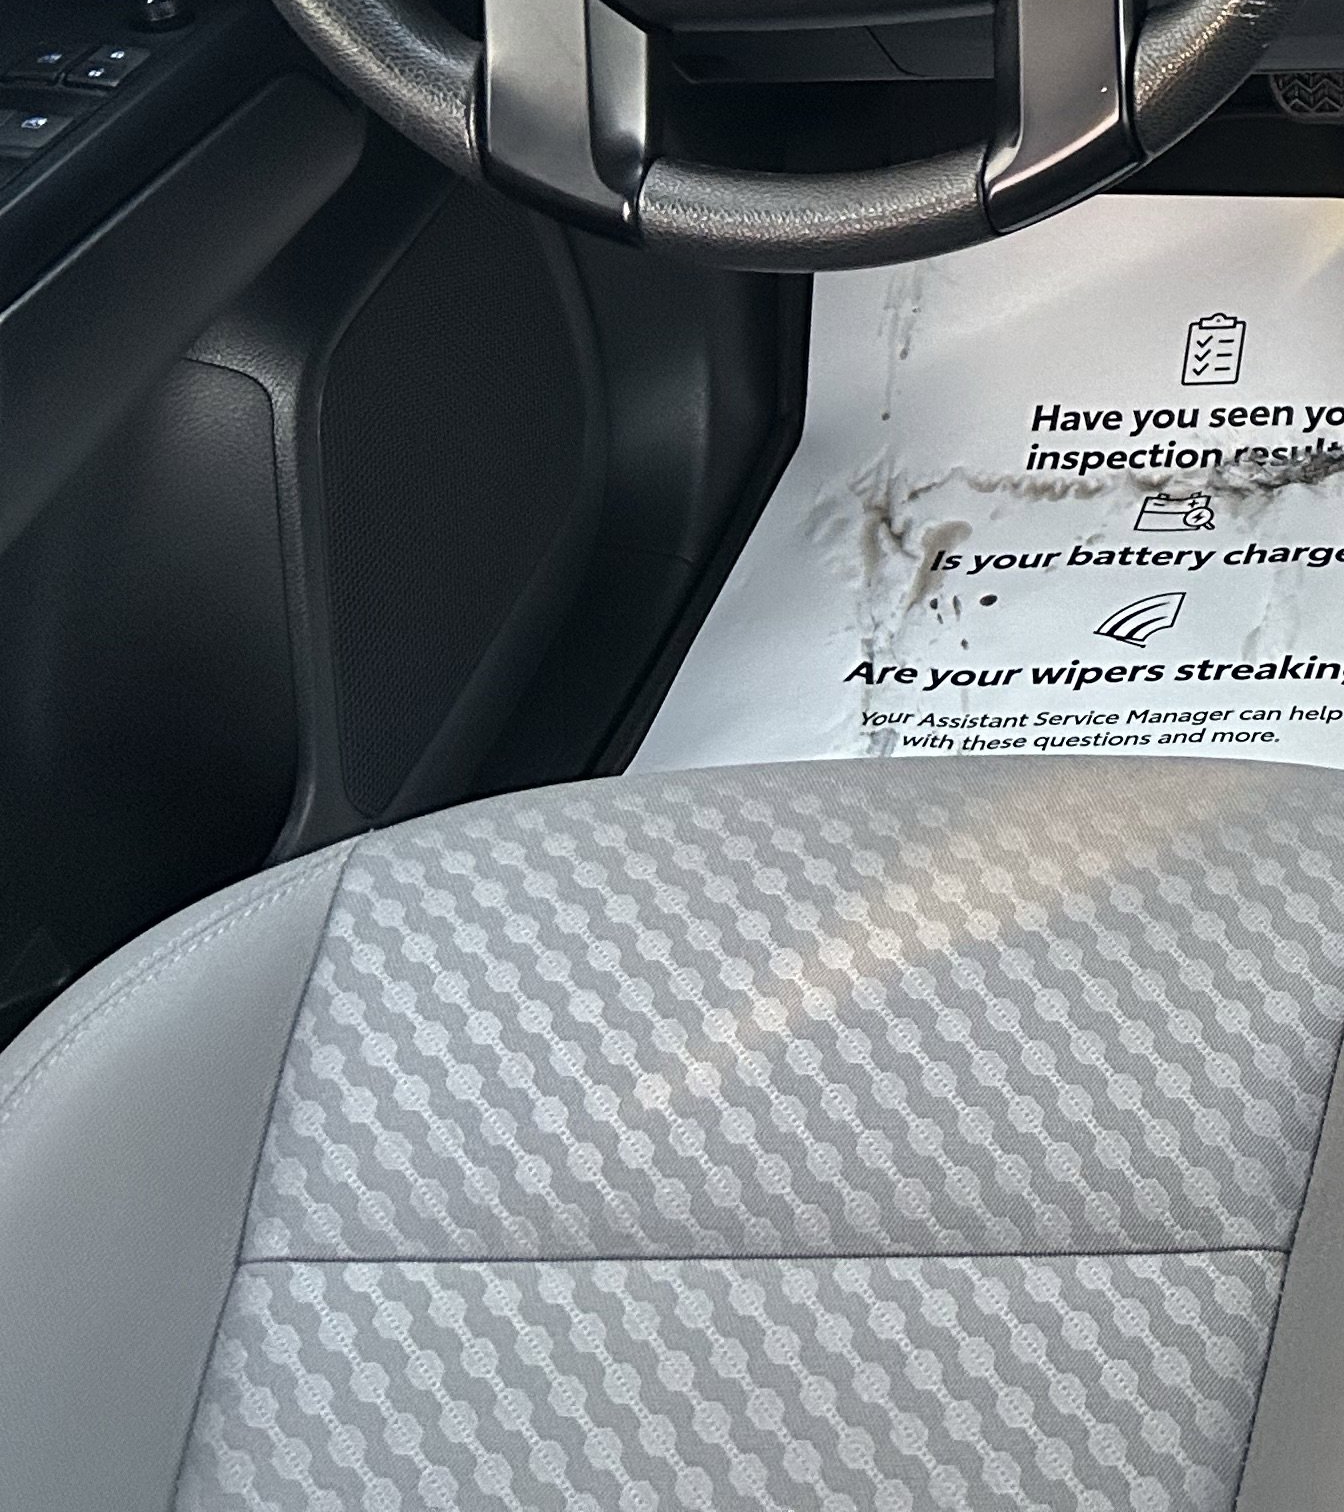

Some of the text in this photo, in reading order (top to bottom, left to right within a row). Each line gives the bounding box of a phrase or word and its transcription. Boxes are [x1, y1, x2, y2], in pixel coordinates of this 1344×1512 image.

[1031, 404, 1123, 432] Have
[1129, 407, 1200, 437] you
[1208, 403, 1294, 429] seen
[1026, 443, 1223, 476] inspection
[930, 548, 963, 572] Is
[965, 548, 1060, 576] your
[1067, 544, 1215, 571] battery
[843, 659, 917, 686] Are
[923, 667, 1023, 692] your
[1030, 658, 1166, 691] wipers
[860, 704, 1344, 729] Your Assistant Service Manager can help
[902, 728, 1281, 752] with these questions and more.
